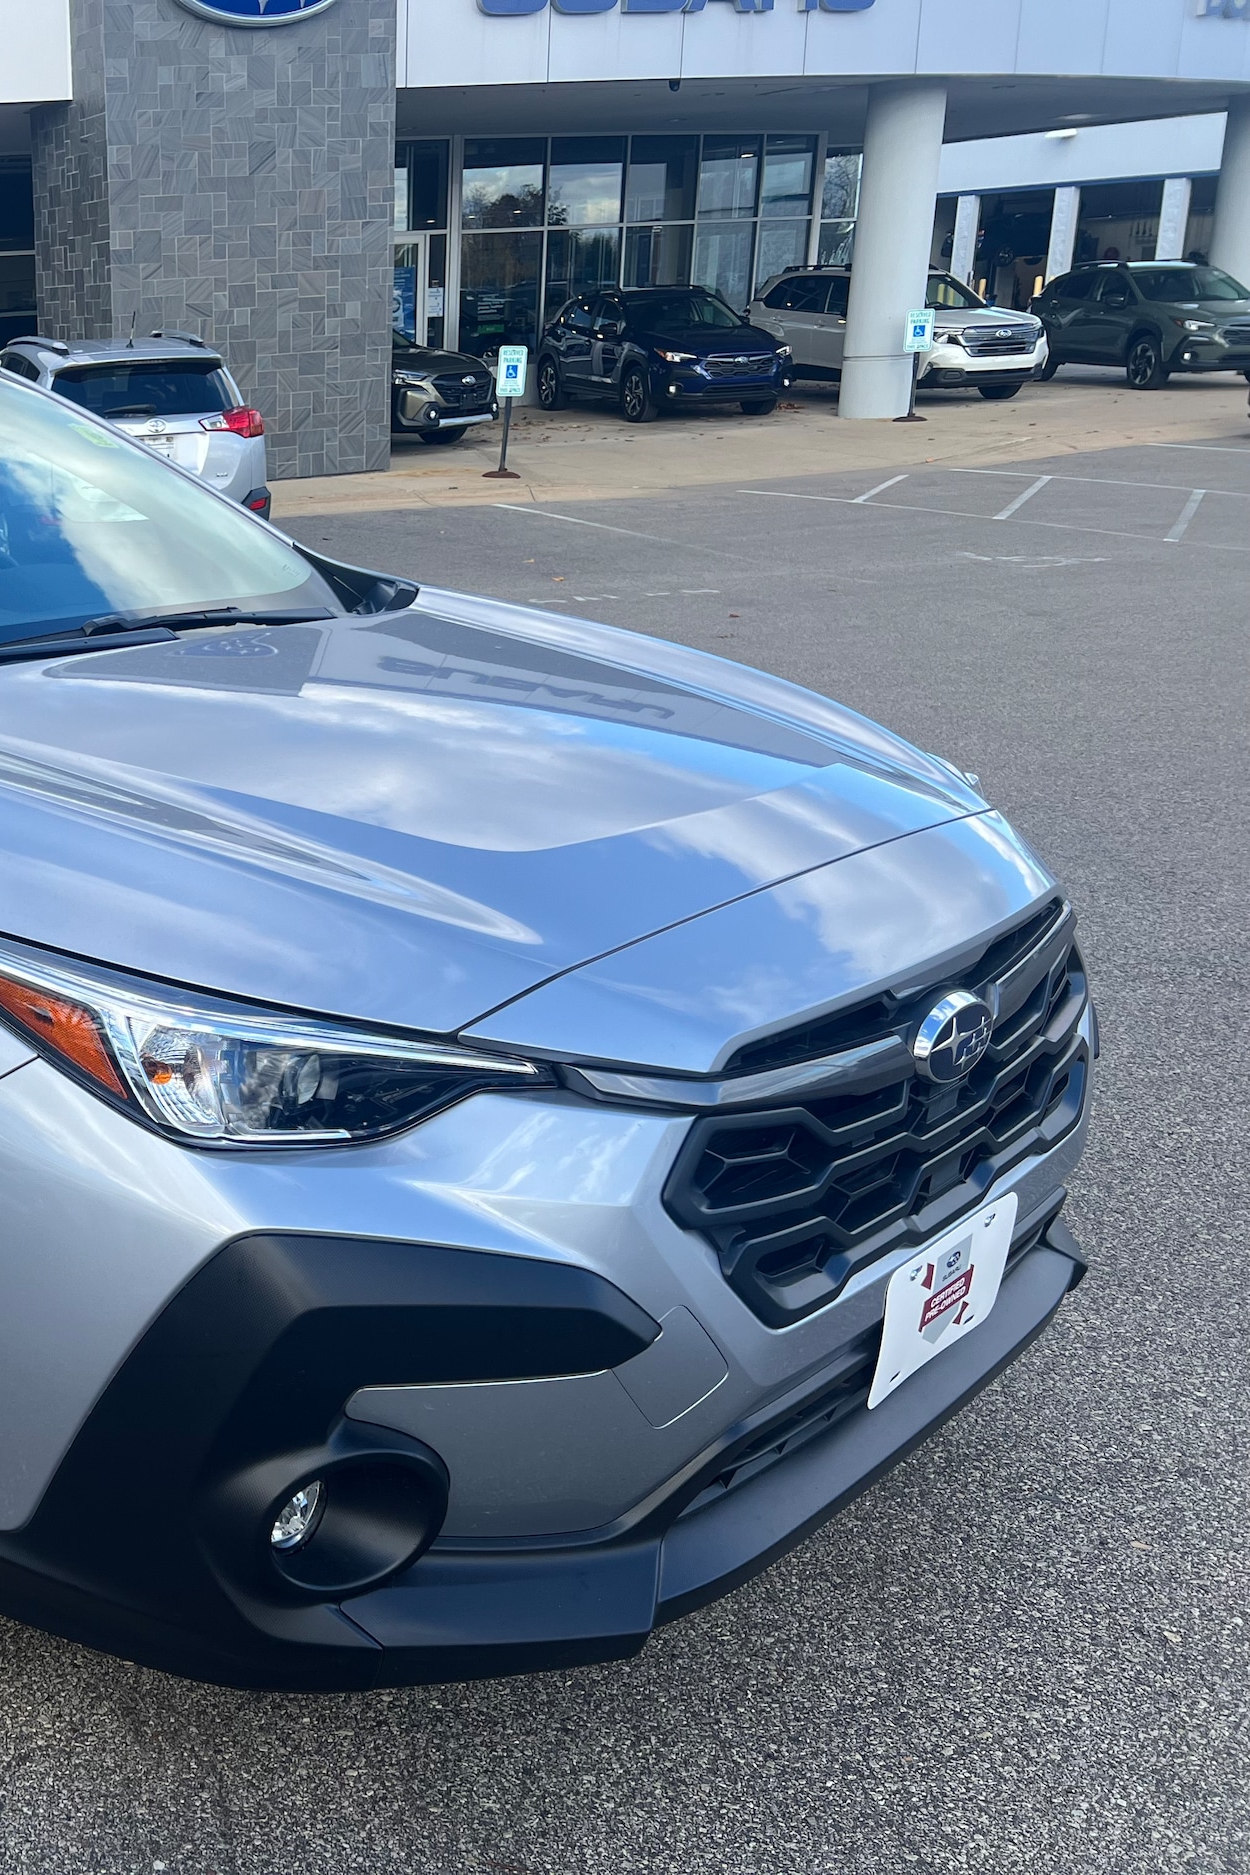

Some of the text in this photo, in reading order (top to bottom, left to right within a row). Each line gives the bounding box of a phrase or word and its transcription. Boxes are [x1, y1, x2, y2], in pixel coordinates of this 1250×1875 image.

[942, 1264, 961, 1282] SUBARU
[925, 1286, 966, 1322] PRE-OWNED
[931, 1277, 965, 1308] CERTIFIED
